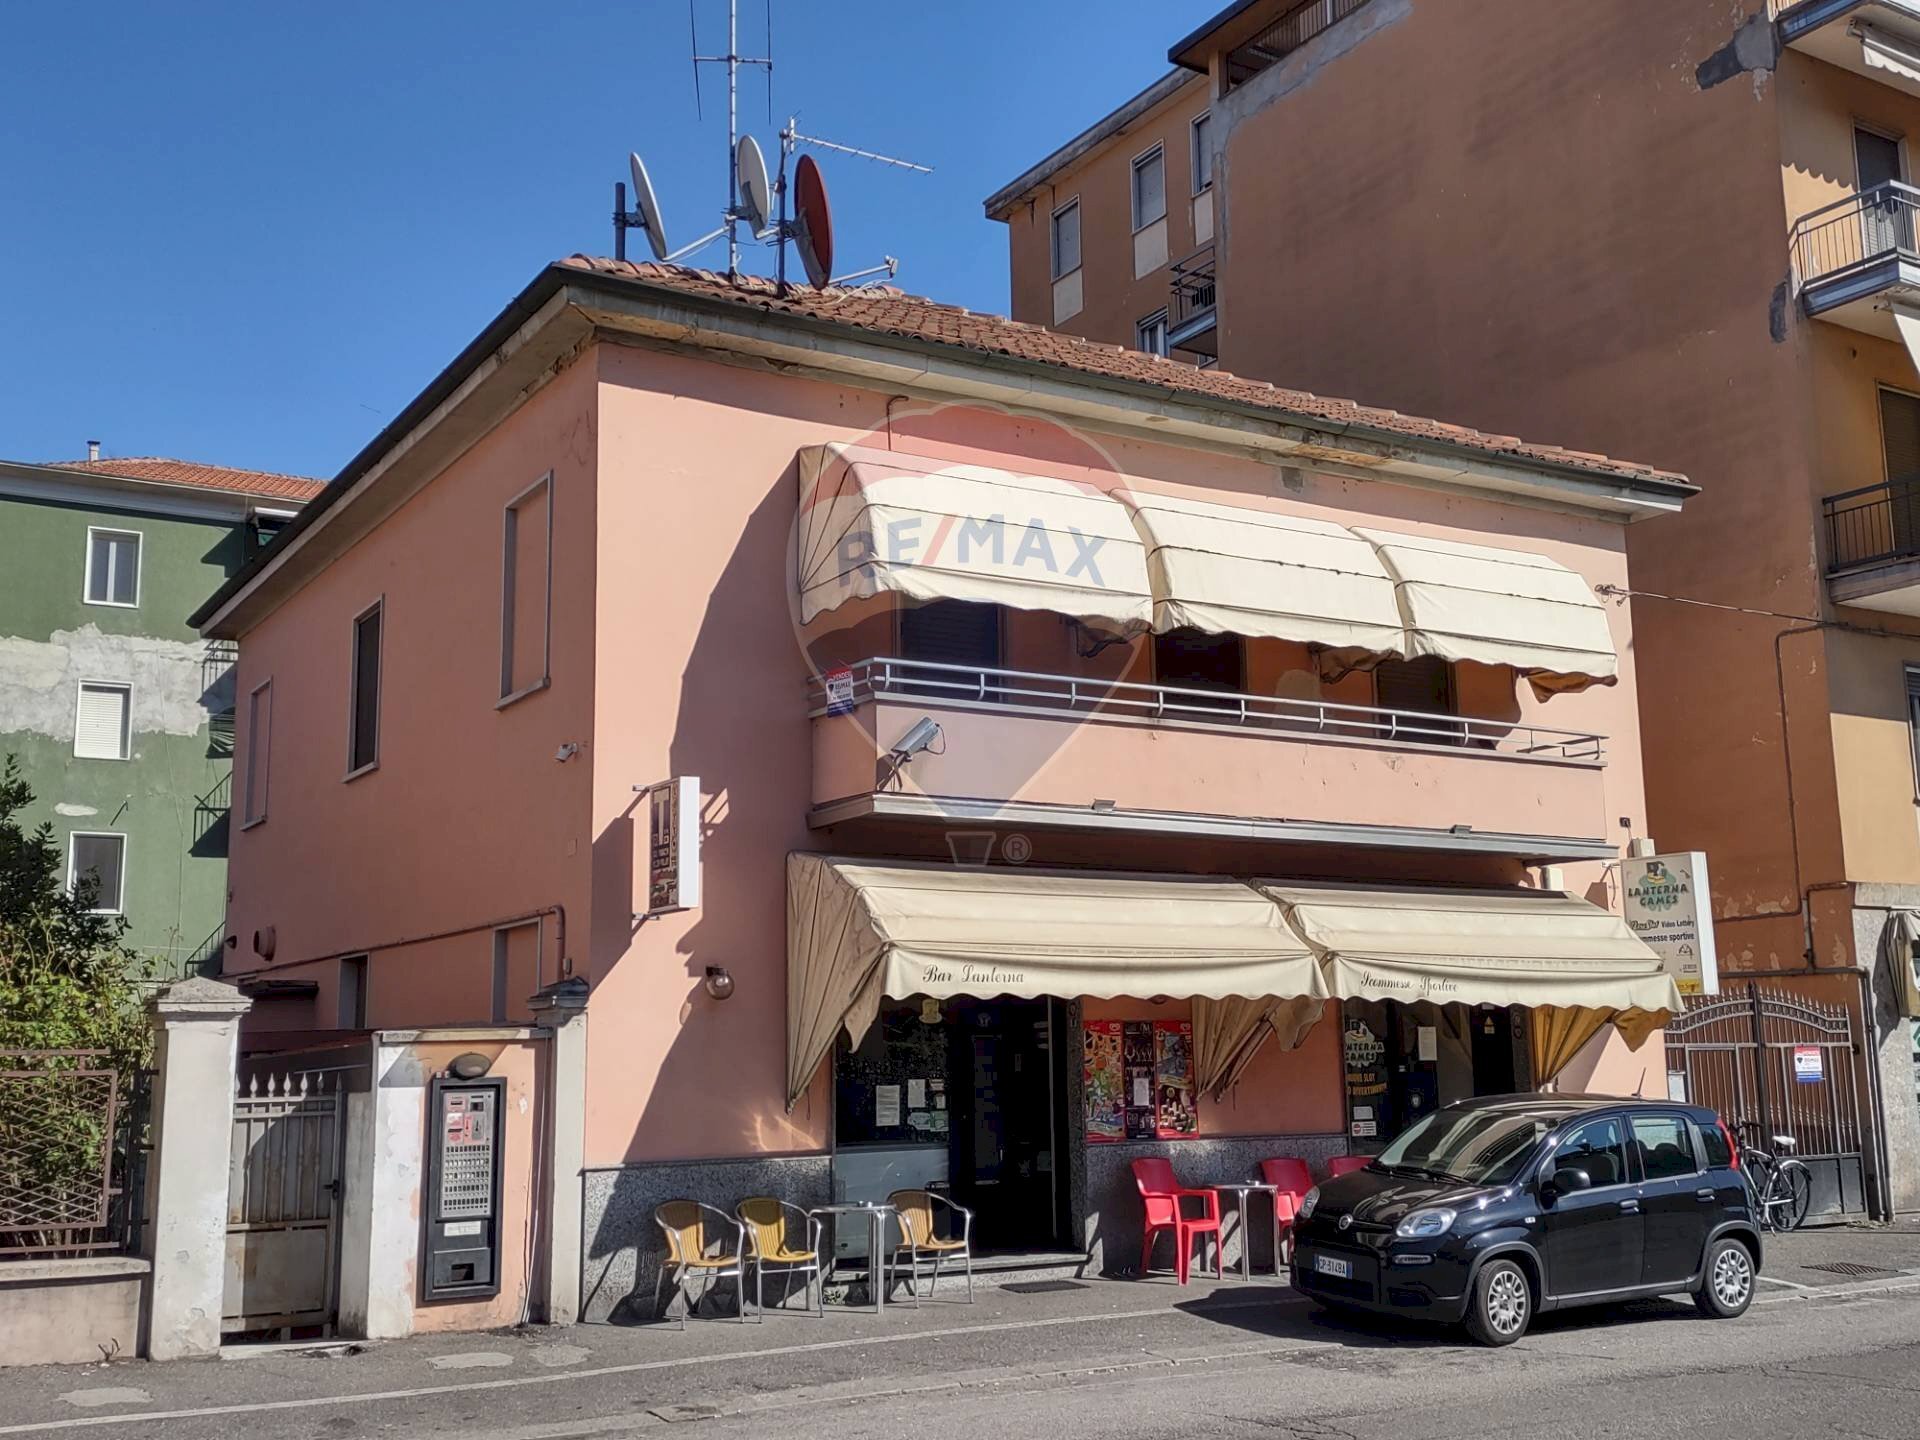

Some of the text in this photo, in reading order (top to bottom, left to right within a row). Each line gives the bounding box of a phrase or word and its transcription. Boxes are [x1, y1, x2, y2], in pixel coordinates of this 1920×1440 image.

[1628, 883, 1689, 898] LANTERNA
[1639, 894, 1679, 907] GAMES
[1669, 931, 1695, 944] sportive
[922, 964, 1025, 983] Bar Lanterna
